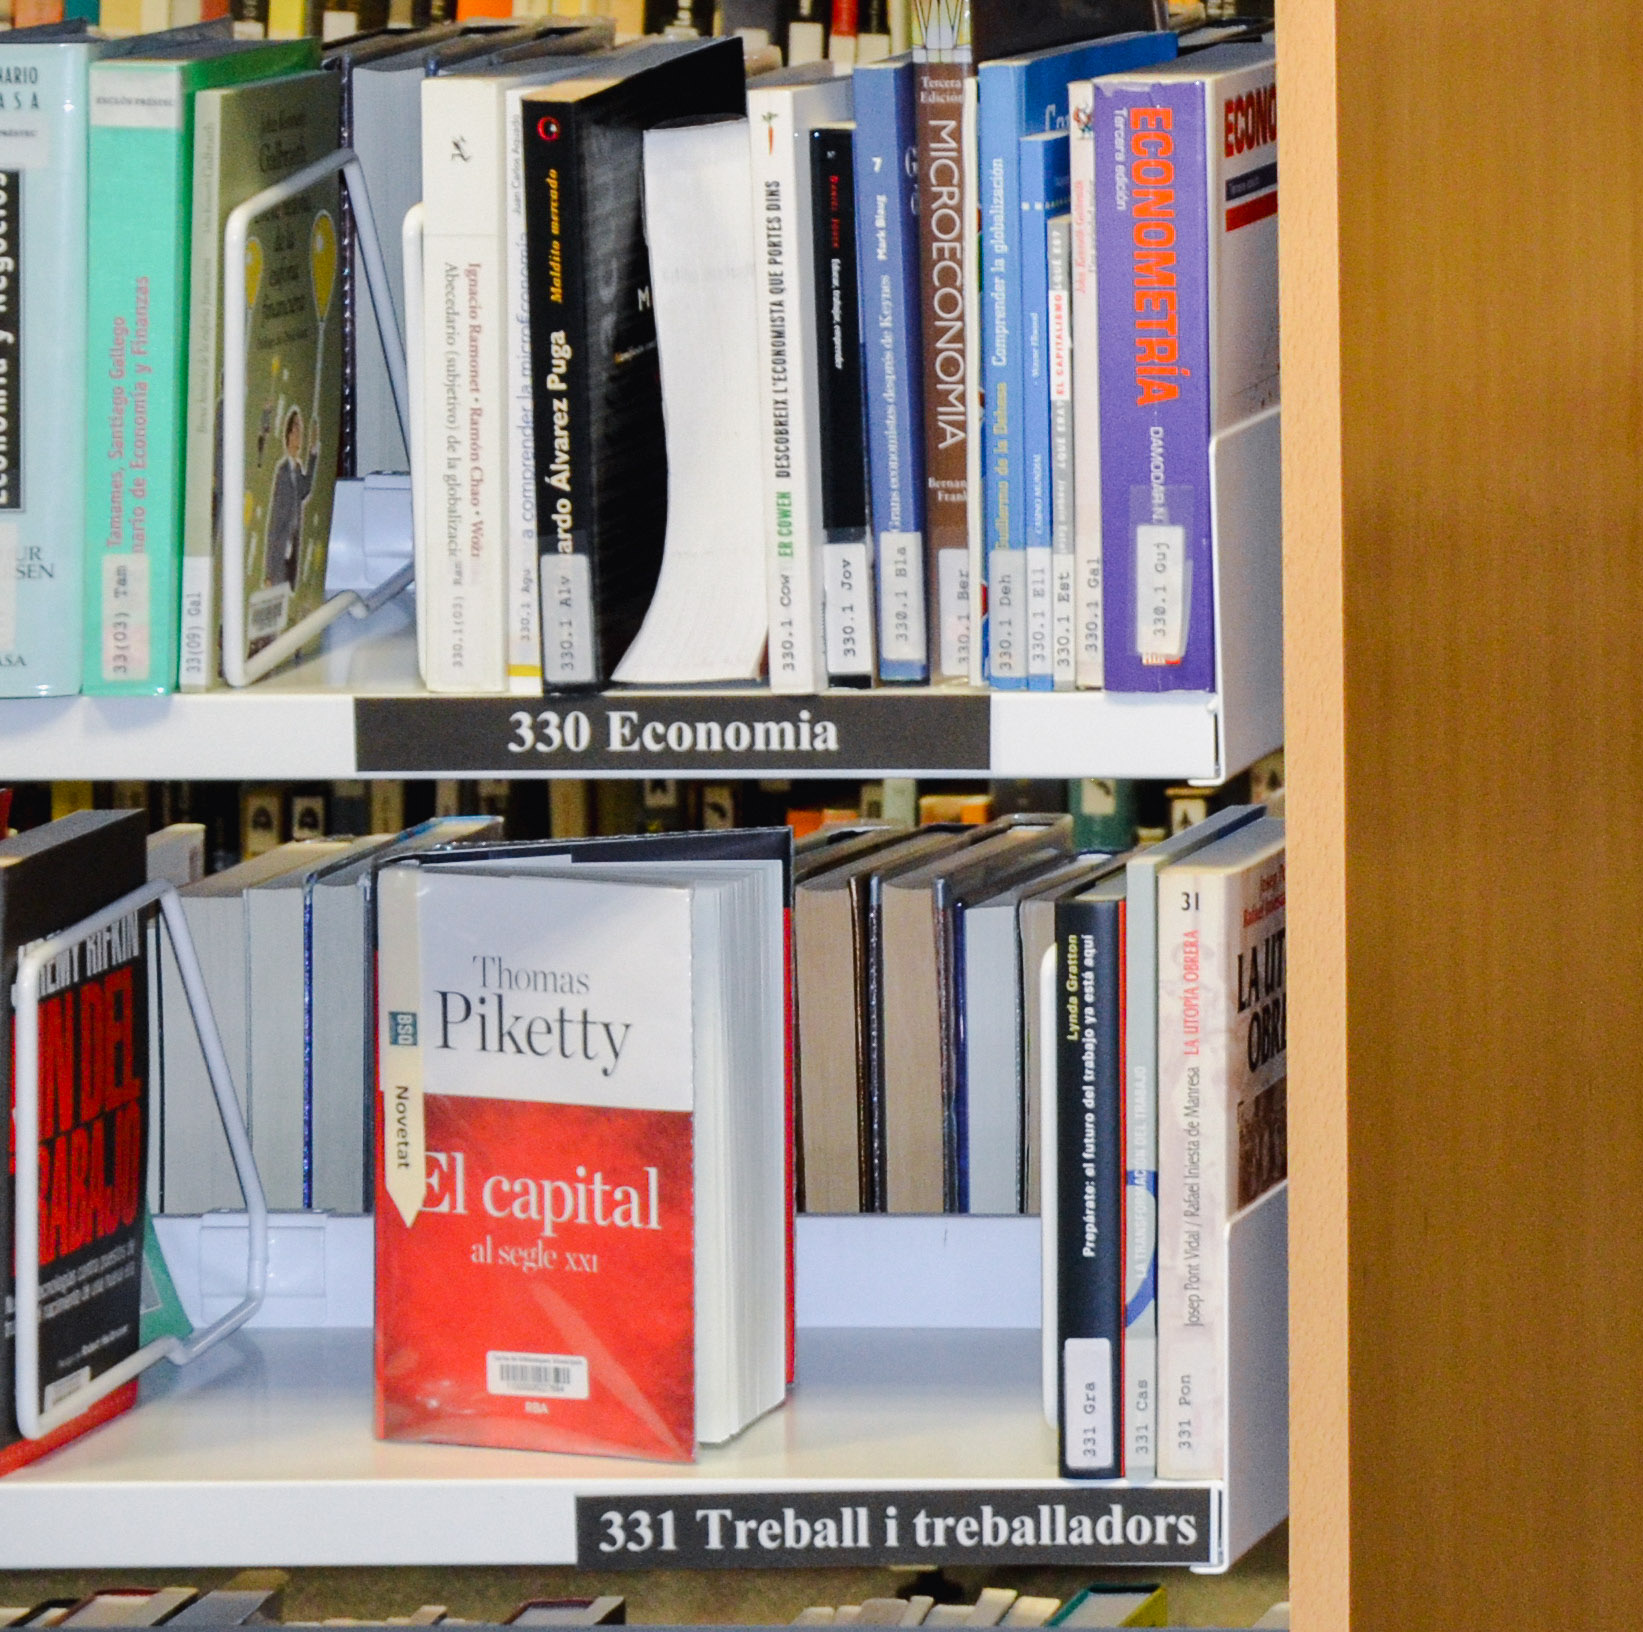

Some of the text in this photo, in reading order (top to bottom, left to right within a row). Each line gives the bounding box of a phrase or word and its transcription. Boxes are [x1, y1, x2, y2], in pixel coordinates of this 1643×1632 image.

[1112, 107, 1129, 210] Tercera edición
[549, 241, 563, 303] Maldito
[989, 158, 1008, 365] Comprender la globalización
[1131, 107, 1190, 406] ECONOMETRÍA
[109, 317, 131, 379] Gallego
[444, 263, 462, 469] Abecedario de la
[468, 324, 484, 394] Ramonet
[764, 180, 791, 478] DESCOBREIX L'ECONOMISTA QUE PORTES DINS
[107, 387, 128, 459] Santiago
[129, 277, 152, 498] de Economía y Finanzas
[545, 330, 572, 491] Álvarez Puga
[469, 466, 485, 506] Chao
[559, 619, 575, 670] 330.1
[841, 559, 857, 657] 330.1 Jov
[999, 574, 1012, 670] 330.1 Deh
[1032, 612, 1046, 661] 330.1
[1057, 615, 1070, 667] 330.1
[1085, 602, 1099, 653] 330.1
[508, 710, 839, 753] 330 Economia
[1181, 892, 1199, 911] 31
[471, 955, 590, 995] Thomas
[1067, 935, 1081, 1040] Lynda Gratton
[1180, 930, 1199, 1055] LA UTOPÍA OBRERA
[434, 990, 633, 1077] Piketty
[395, 1086, 410, 1170] Novetat
[1082, 935, 1099, 1257] Prepárate: el futuro del trabajo ya está aquí
[421, 1152, 662, 1238] El capital
[1184, 1067, 1201, 1327] Josep Pont Vidal Rafael Iniesta de Manresa
[471, 1235, 558, 1273] al segle
[1082, 1382, 1096, 1457] 331 Gra
[1135, 1379, 1148, 1454] 331 Cas
[1178, 1375, 1191, 1449] 331 Pon
[599, 1504, 1198, 1552] 331 Treball i treballadors
